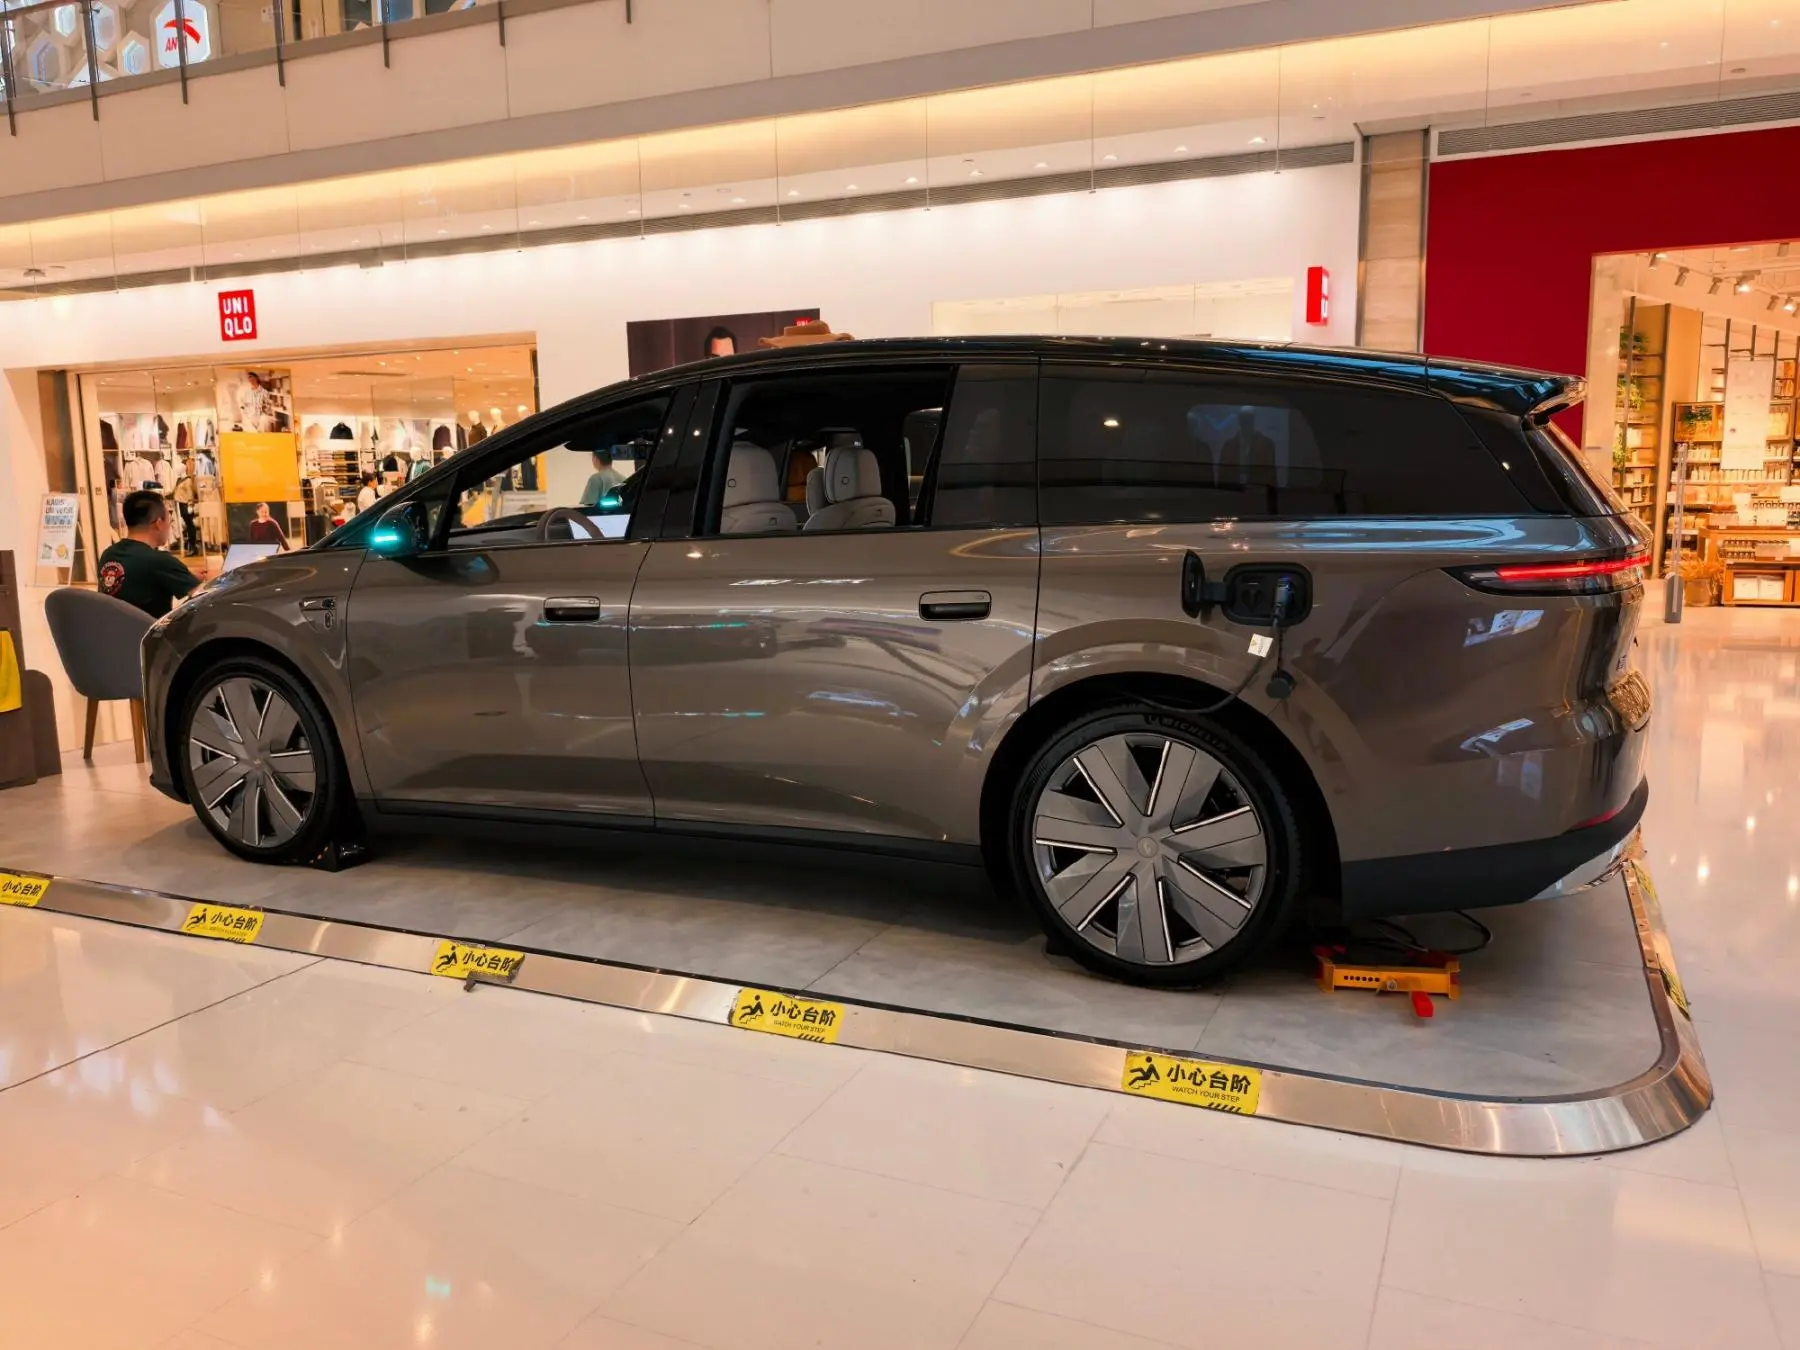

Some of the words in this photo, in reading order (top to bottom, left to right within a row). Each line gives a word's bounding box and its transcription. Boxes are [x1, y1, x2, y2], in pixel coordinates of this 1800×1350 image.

[223, 296, 249, 314] UNI
[224, 316, 253, 338] QLO
[210, 912, 258, 931] 小心台阶
[462, 951, 516, 972] 小心台阶
[770, 1001, 836, 1026] 小心台阶
[1166, 1064, 1252, 1095] 小心台阶
[1172, 1086, 1198, 1095] WATCH
[1199, 1090, 1220, 1099] YOUR
[1220, 1094, 1240, 1102] STEP
